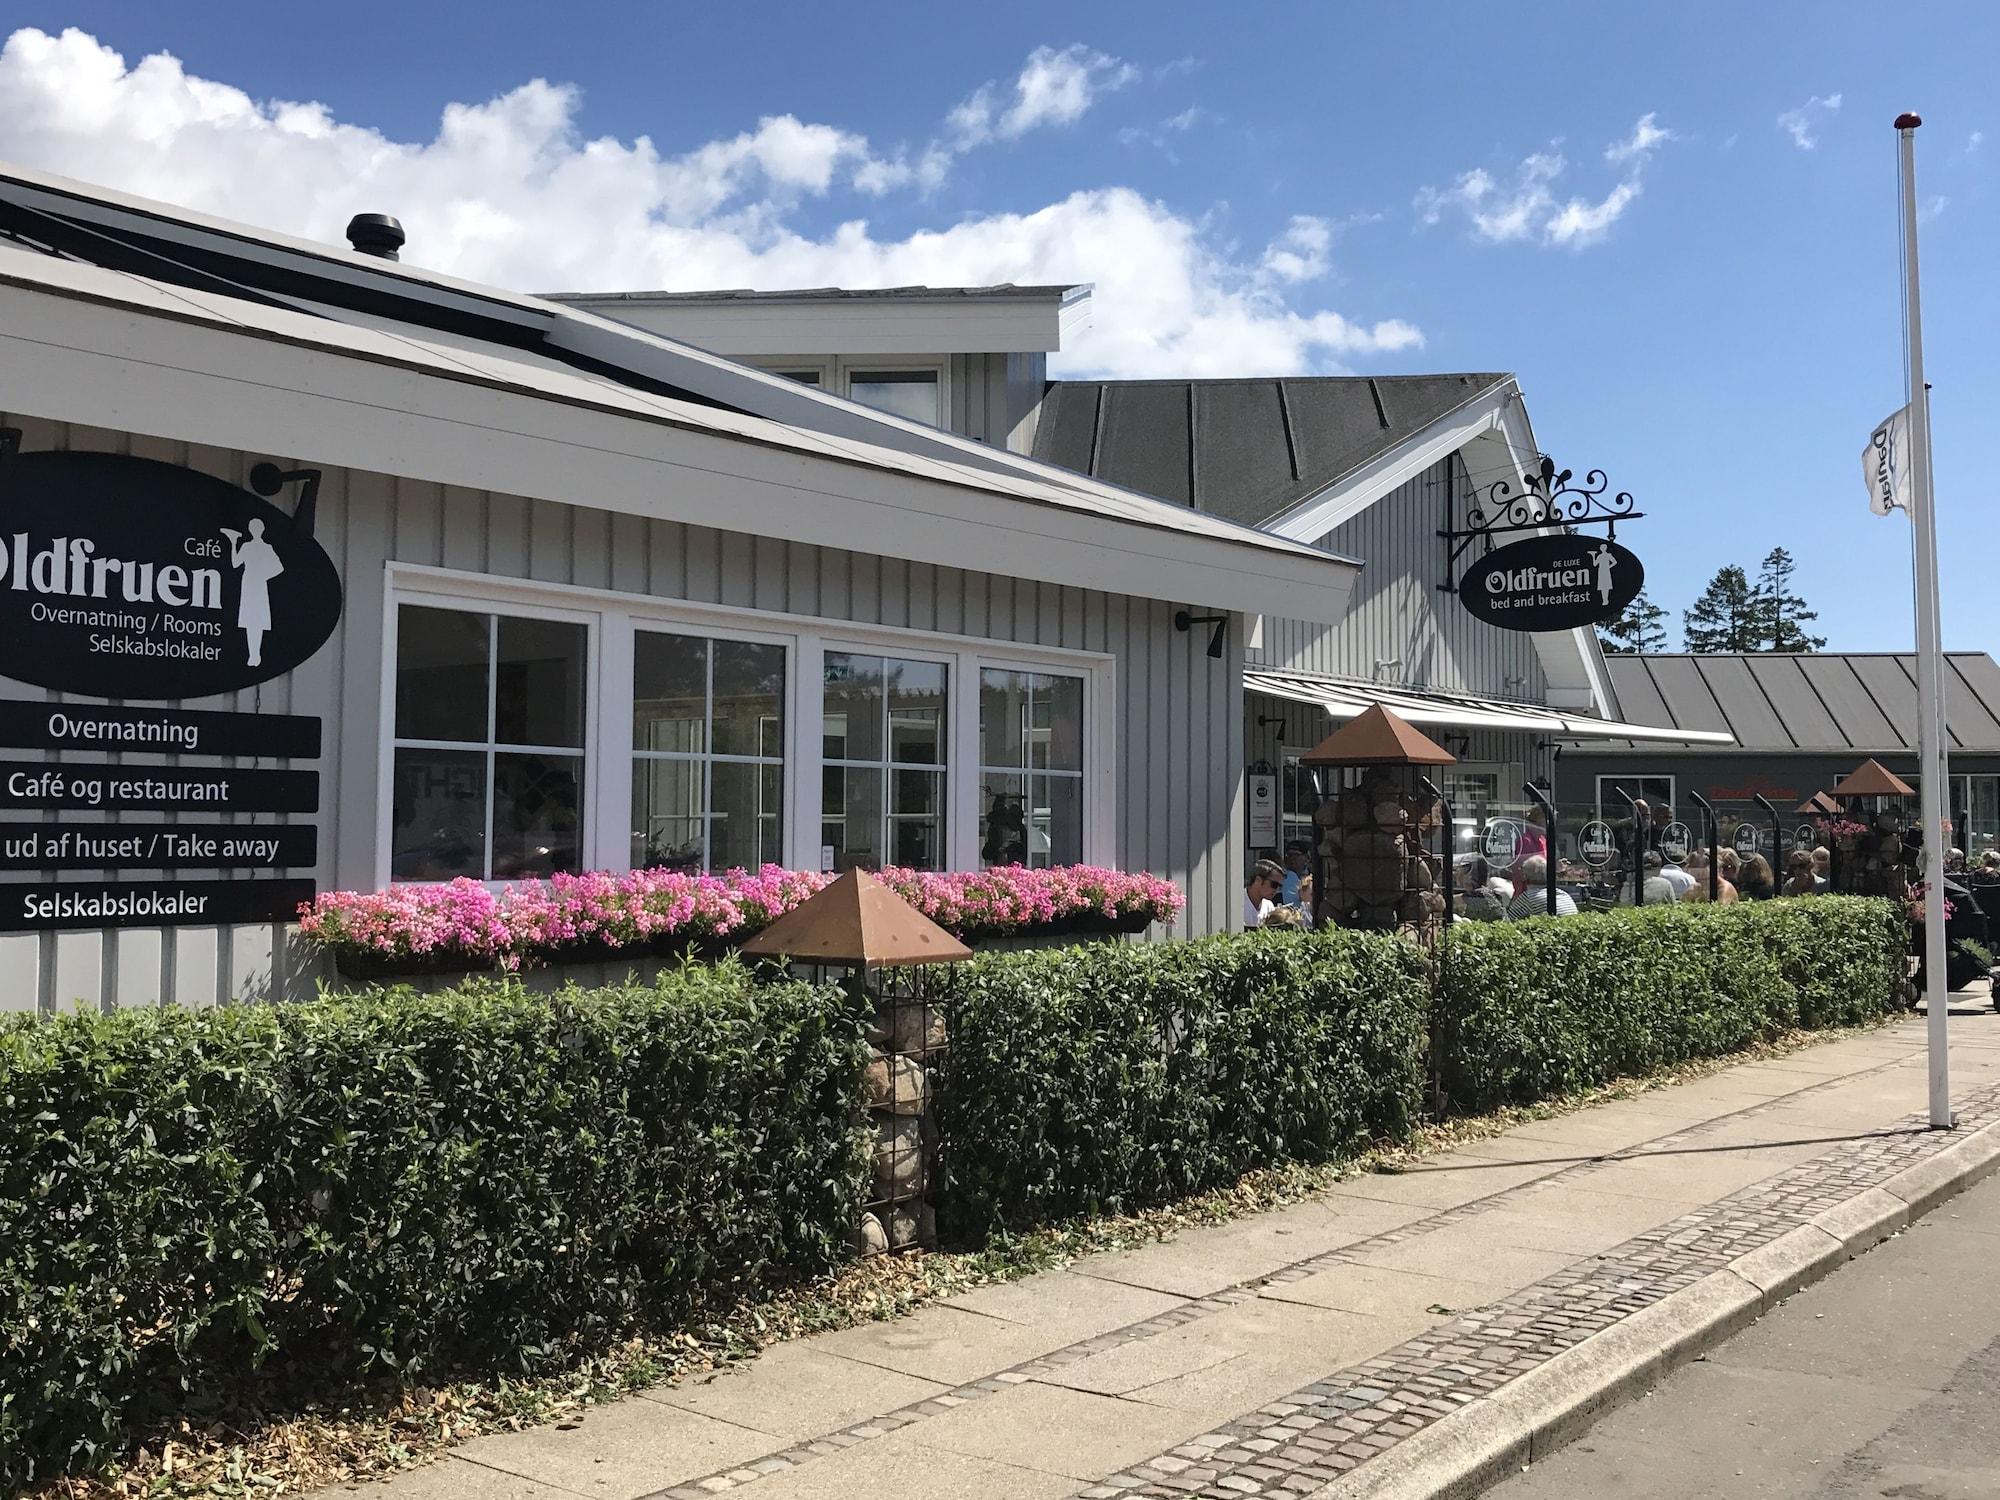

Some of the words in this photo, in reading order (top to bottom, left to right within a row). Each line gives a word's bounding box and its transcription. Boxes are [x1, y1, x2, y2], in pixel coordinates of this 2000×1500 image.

[185, 538, 221, 557] Café
[0, 532, 222, 609] ldfruen
[1552, 560, 1562, 568] DE
[1563, 558, 1580, 567] LUXE
[1485, 567, 1590, 594] Oldfruen
[1490, 597, 1510, 610] bed
[1514, 595, 1534, 608] and
[1538, 591, 1591, 605] breakfast
[31, 602, 147, 633] Overnatning
[151, 614, 159, 630] /
[164, 615, 221, 636] Rooms
[89, 634, 222, 661] Selskabslokaler
[49, 713, 198, 749] Overnatning
[9, 772, 64, 797] Café
[72, 781, 101, 804] og
[110, 779, 228, 800] restaurant
[6, 833, 37, 857] ud
[46, 833, 70, 857] af
[76, 833, 142, 857] huset
[148, 834, 158, 857] /
[164, 834, 216, 856] Take
[223, 840, 279, 862] away
[24, 891, 207, 918] Selskabslokaler
